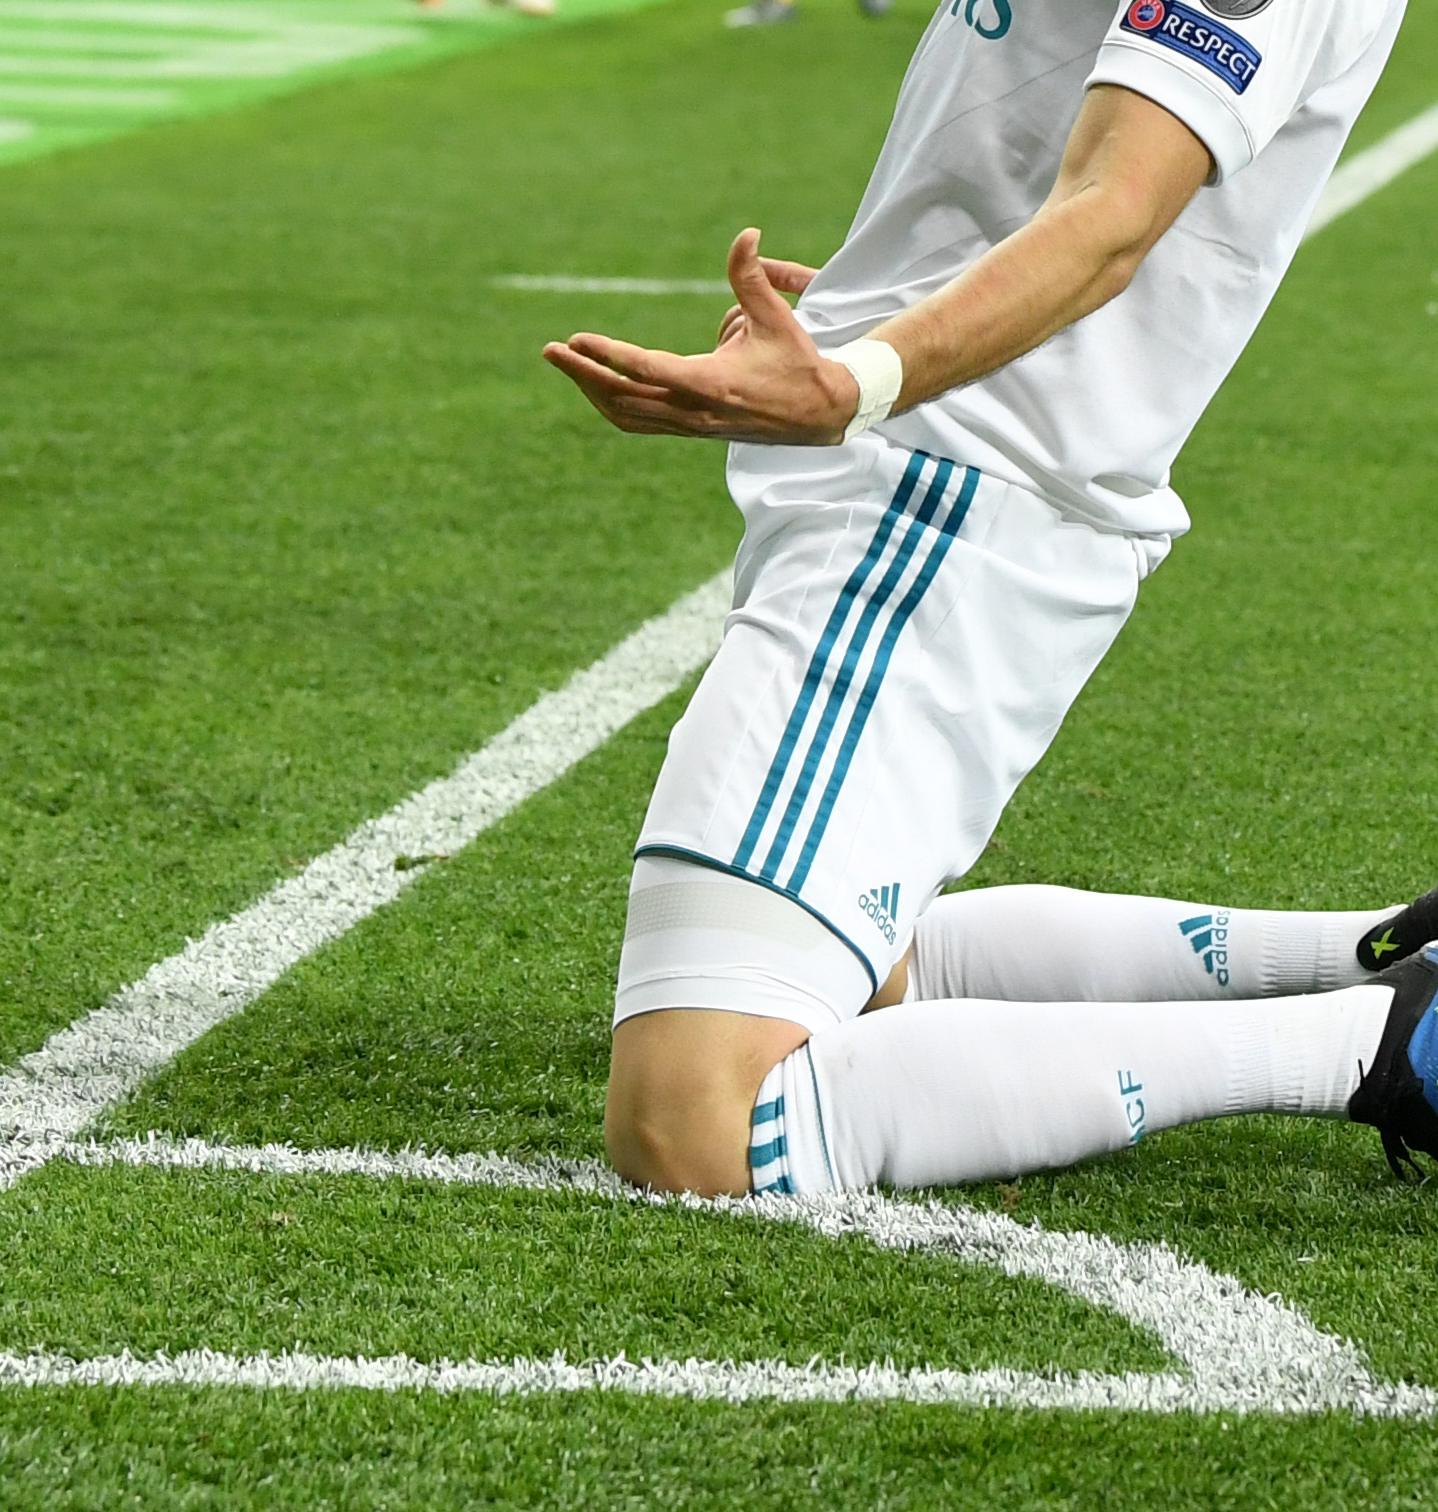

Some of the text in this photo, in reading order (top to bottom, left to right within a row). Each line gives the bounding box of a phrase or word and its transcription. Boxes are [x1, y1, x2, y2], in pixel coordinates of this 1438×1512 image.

[1161, 13, 1256, 81] RESPECT
[857, 893, 897, 946] adidas
[1214, 910, 1231, 987] adidas
[1117, 1070, 1145, 1142] CF
